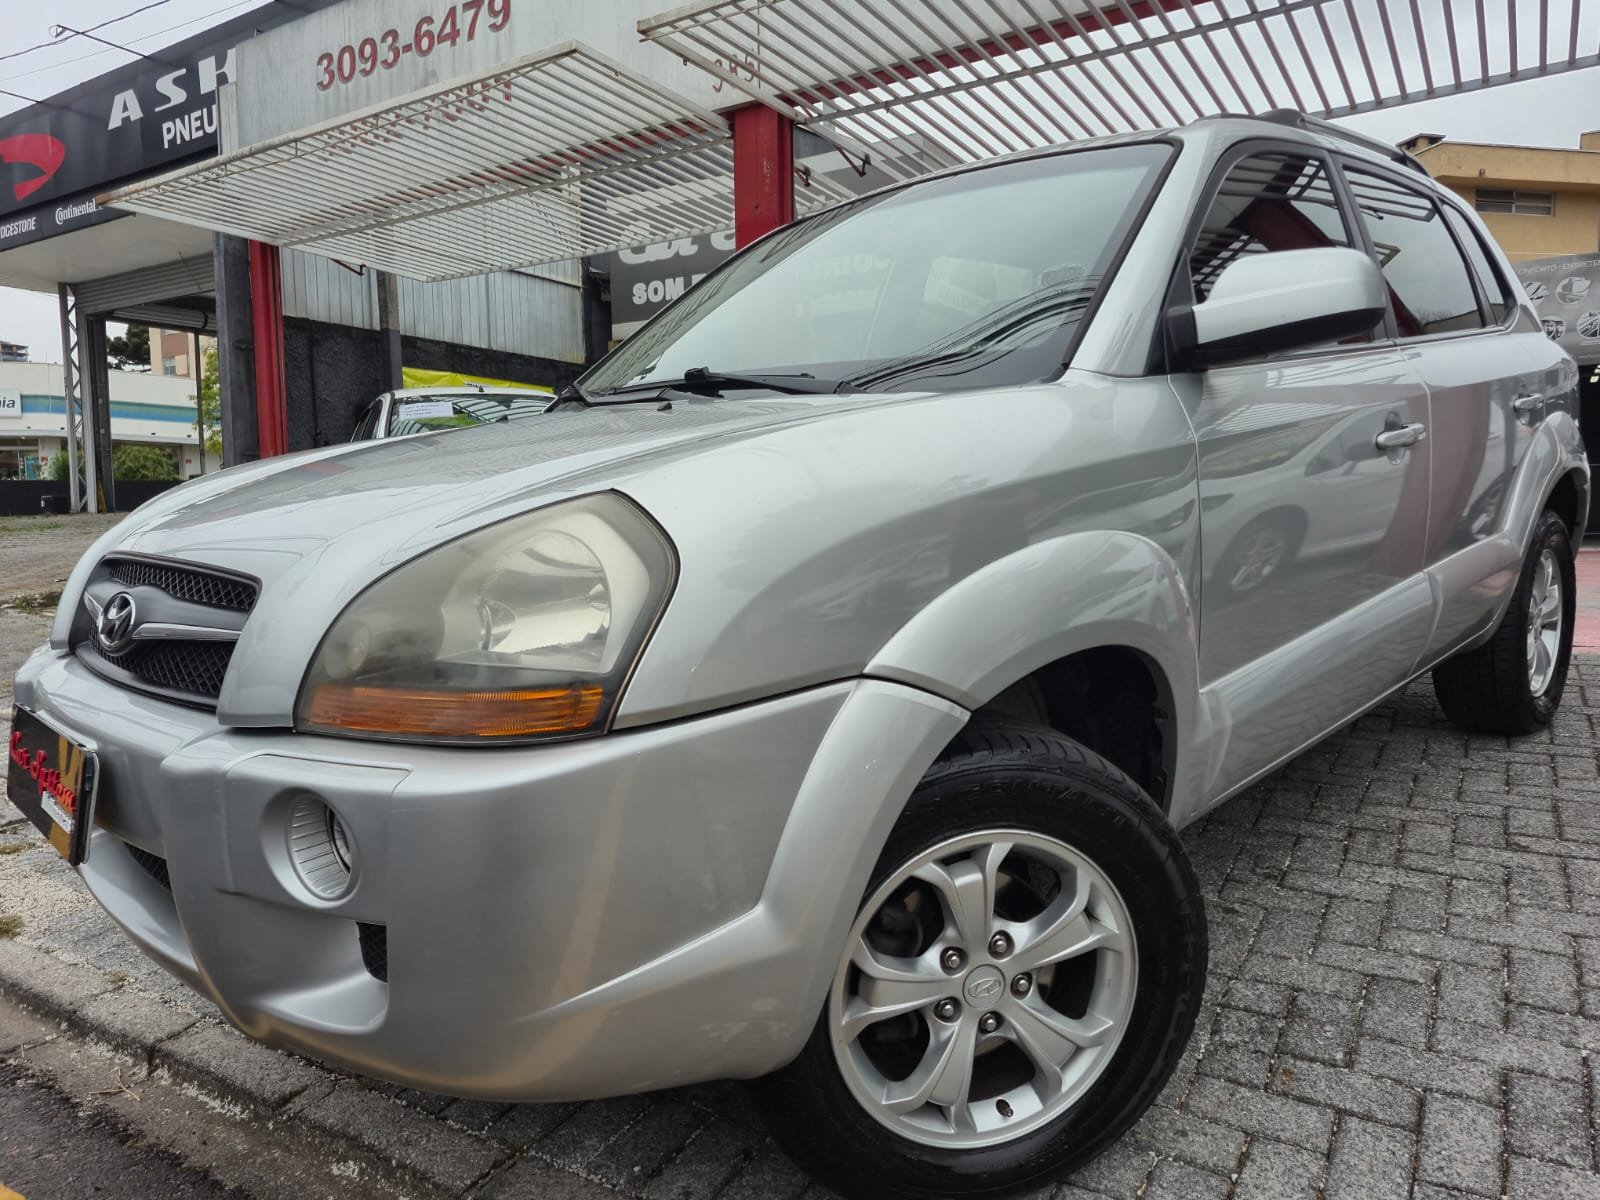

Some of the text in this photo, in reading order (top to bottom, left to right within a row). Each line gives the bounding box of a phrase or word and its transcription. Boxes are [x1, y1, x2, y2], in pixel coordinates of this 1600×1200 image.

[316, 0, 512, 92] 3093-6479
[162, 104, 217, 149] PNEU
[55, 198, 97, 225] Continental
[0, 216, 37, 239] DGESTONE
[632, 276, 685, 305] SOM
